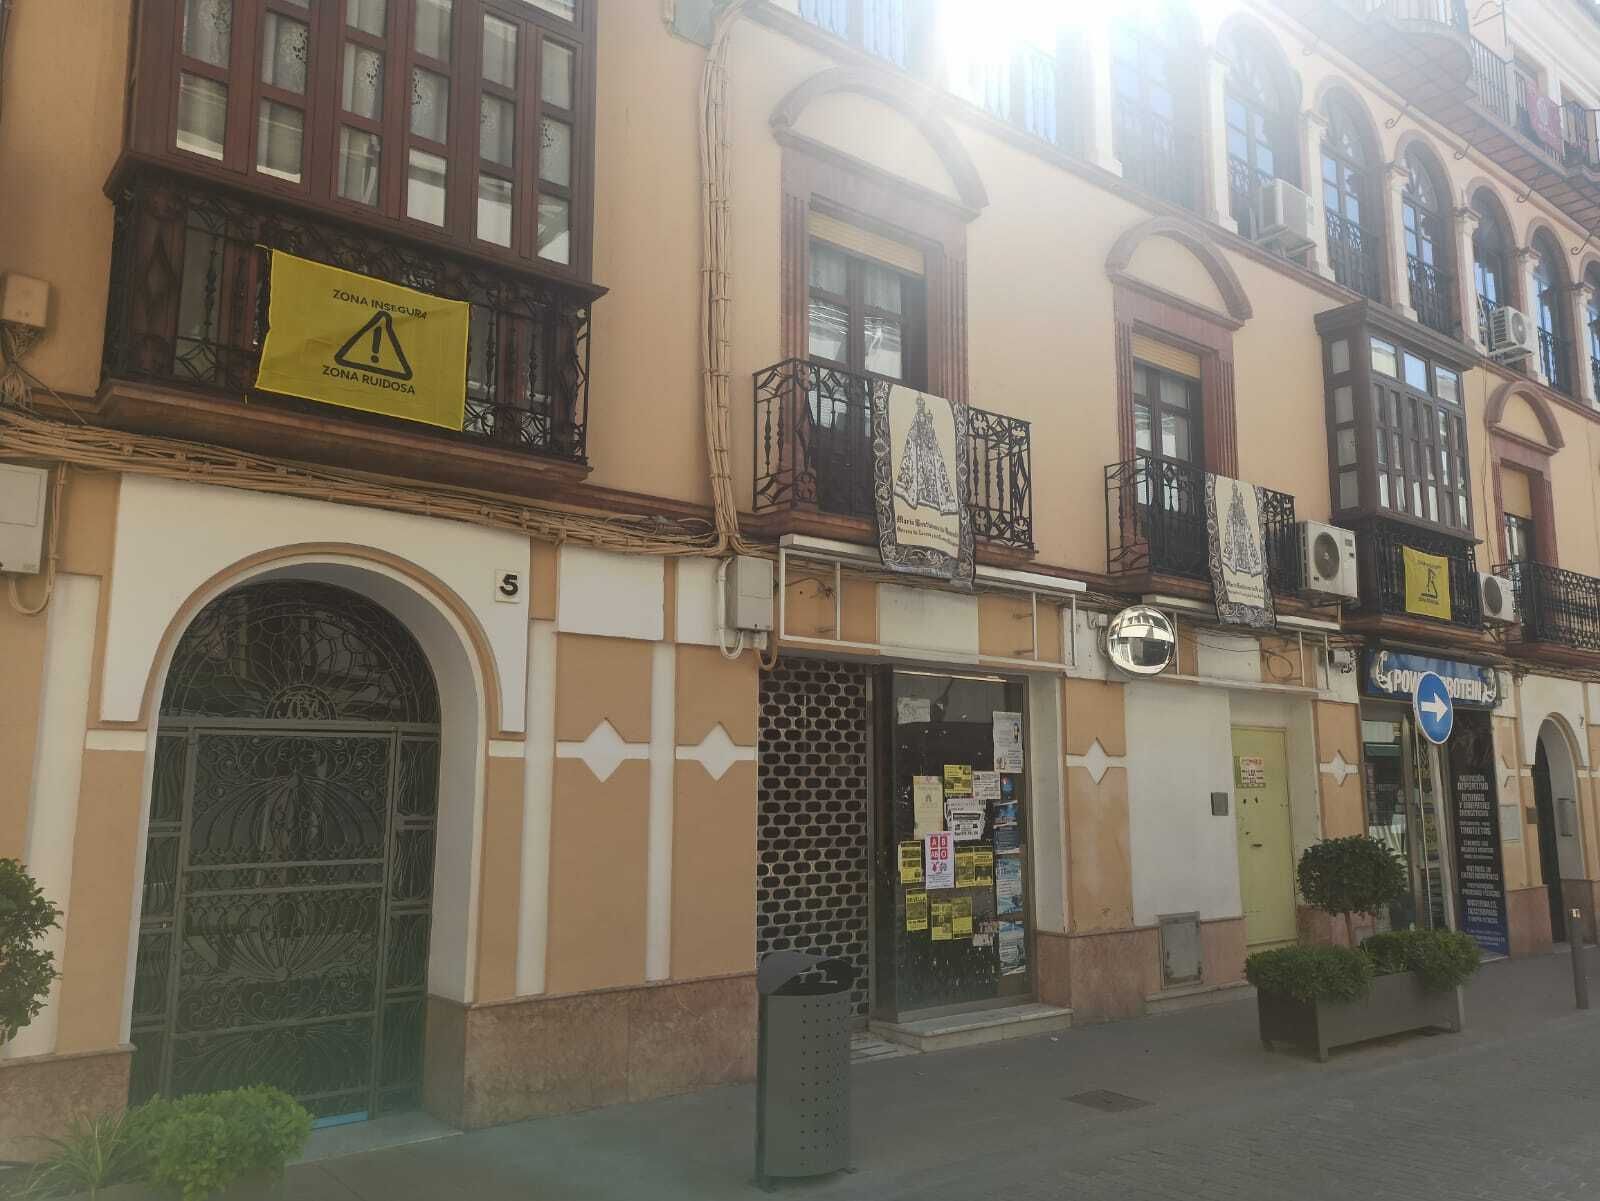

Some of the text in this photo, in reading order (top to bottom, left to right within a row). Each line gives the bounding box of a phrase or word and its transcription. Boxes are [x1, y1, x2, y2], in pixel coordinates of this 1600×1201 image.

[332, 288, 428, 320] ZONA INSEGURA
[321, 364, 416, 395] ZONA RUIDOSA
[500, 573, 518, 596] 5
[1393, 669, 1482, 701] POW ROTEIN
